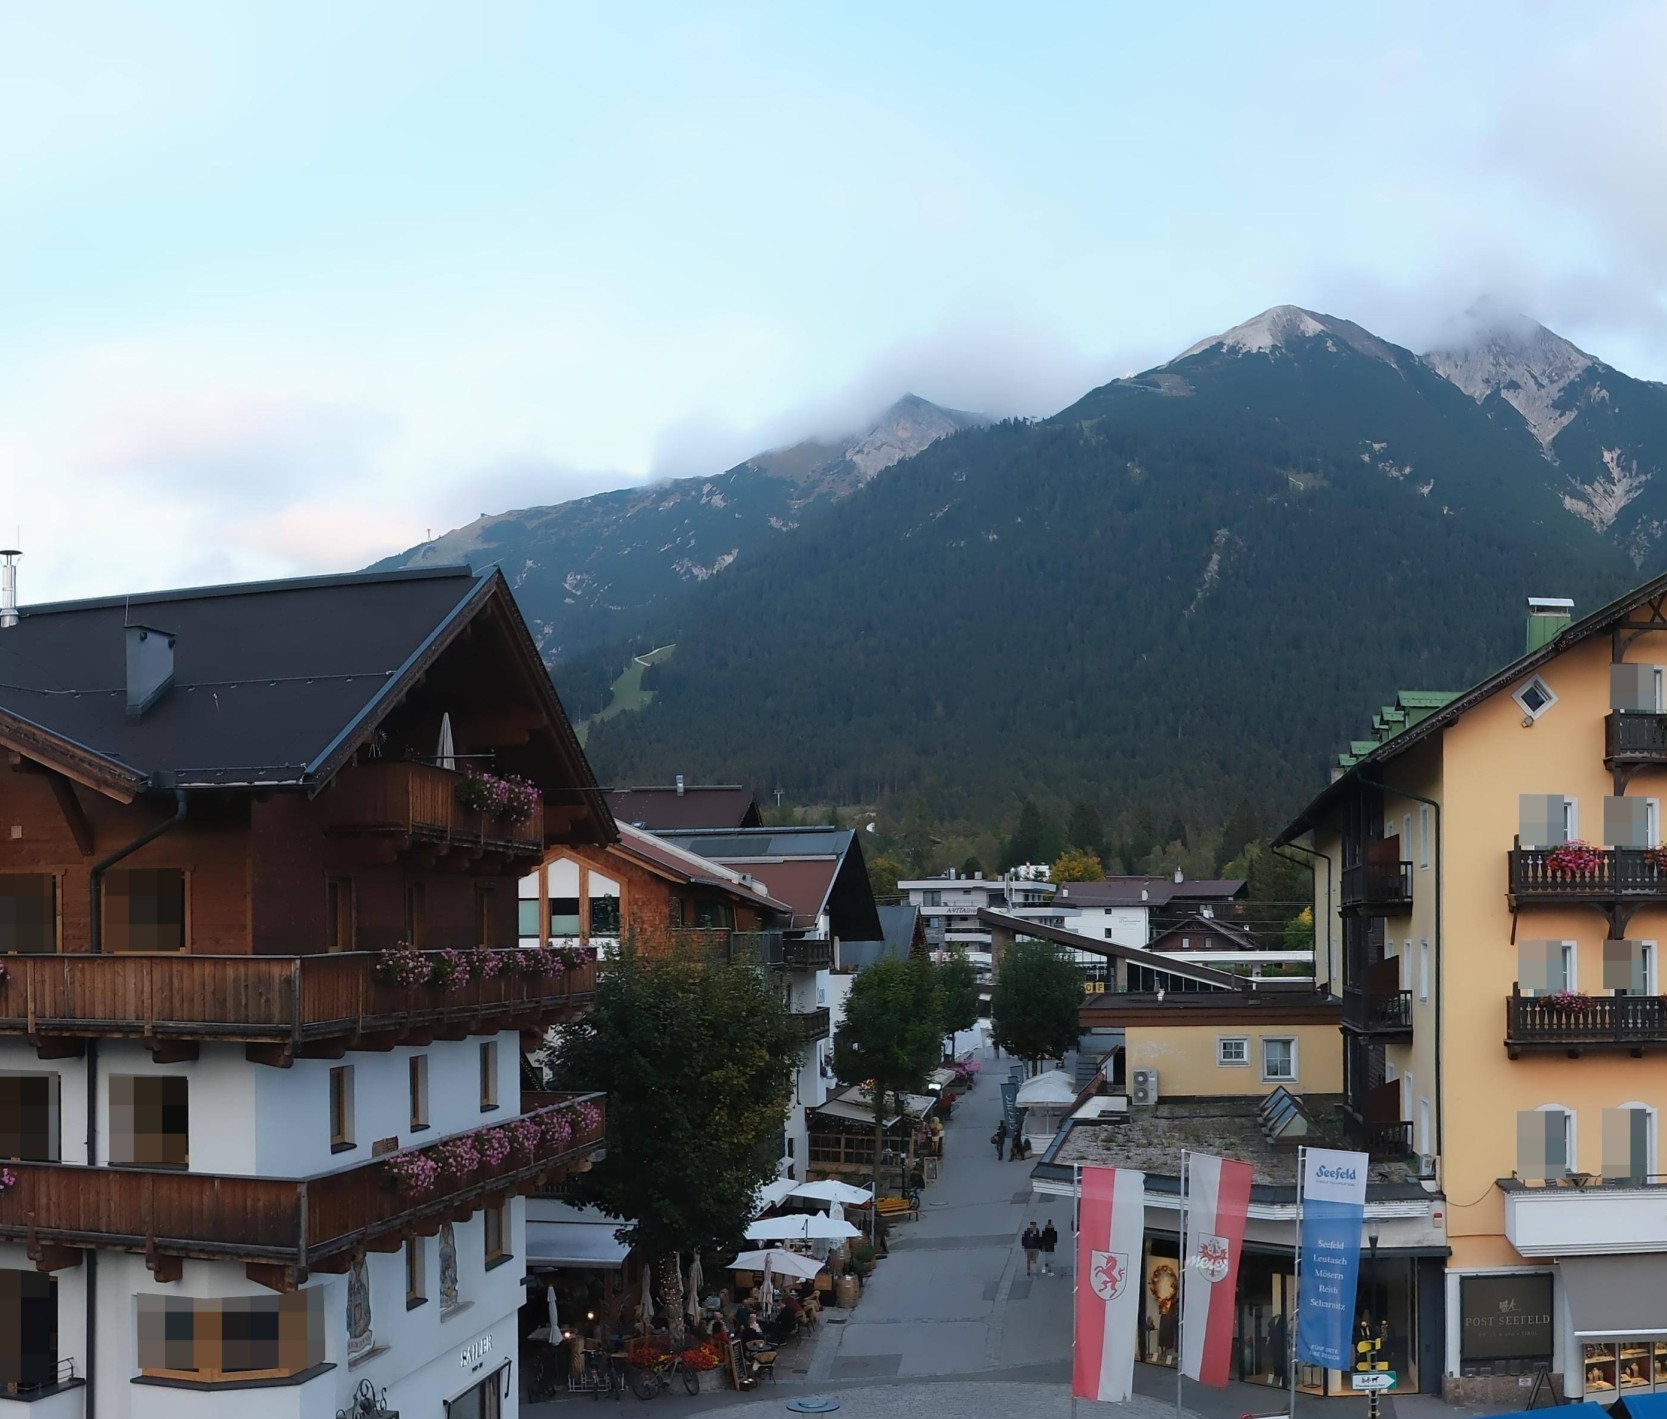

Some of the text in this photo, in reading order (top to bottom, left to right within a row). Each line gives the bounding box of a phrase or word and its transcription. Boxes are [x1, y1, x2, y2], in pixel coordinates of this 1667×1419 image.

[1316, 1165, 1356, 1180] Seefeld
[1318, 1240, 1344, 1249] Seefeld
[1313, 1254, 1347, 1265] Leutasch
[1315, 1268, 1344, 1280] Mösern
[1319, 1284, 1338, 1295] Reith
[1310, 1298, 1346, 1311] Scharnitz
[1465, 1315, 1550, 1327] POST SEEFELD
